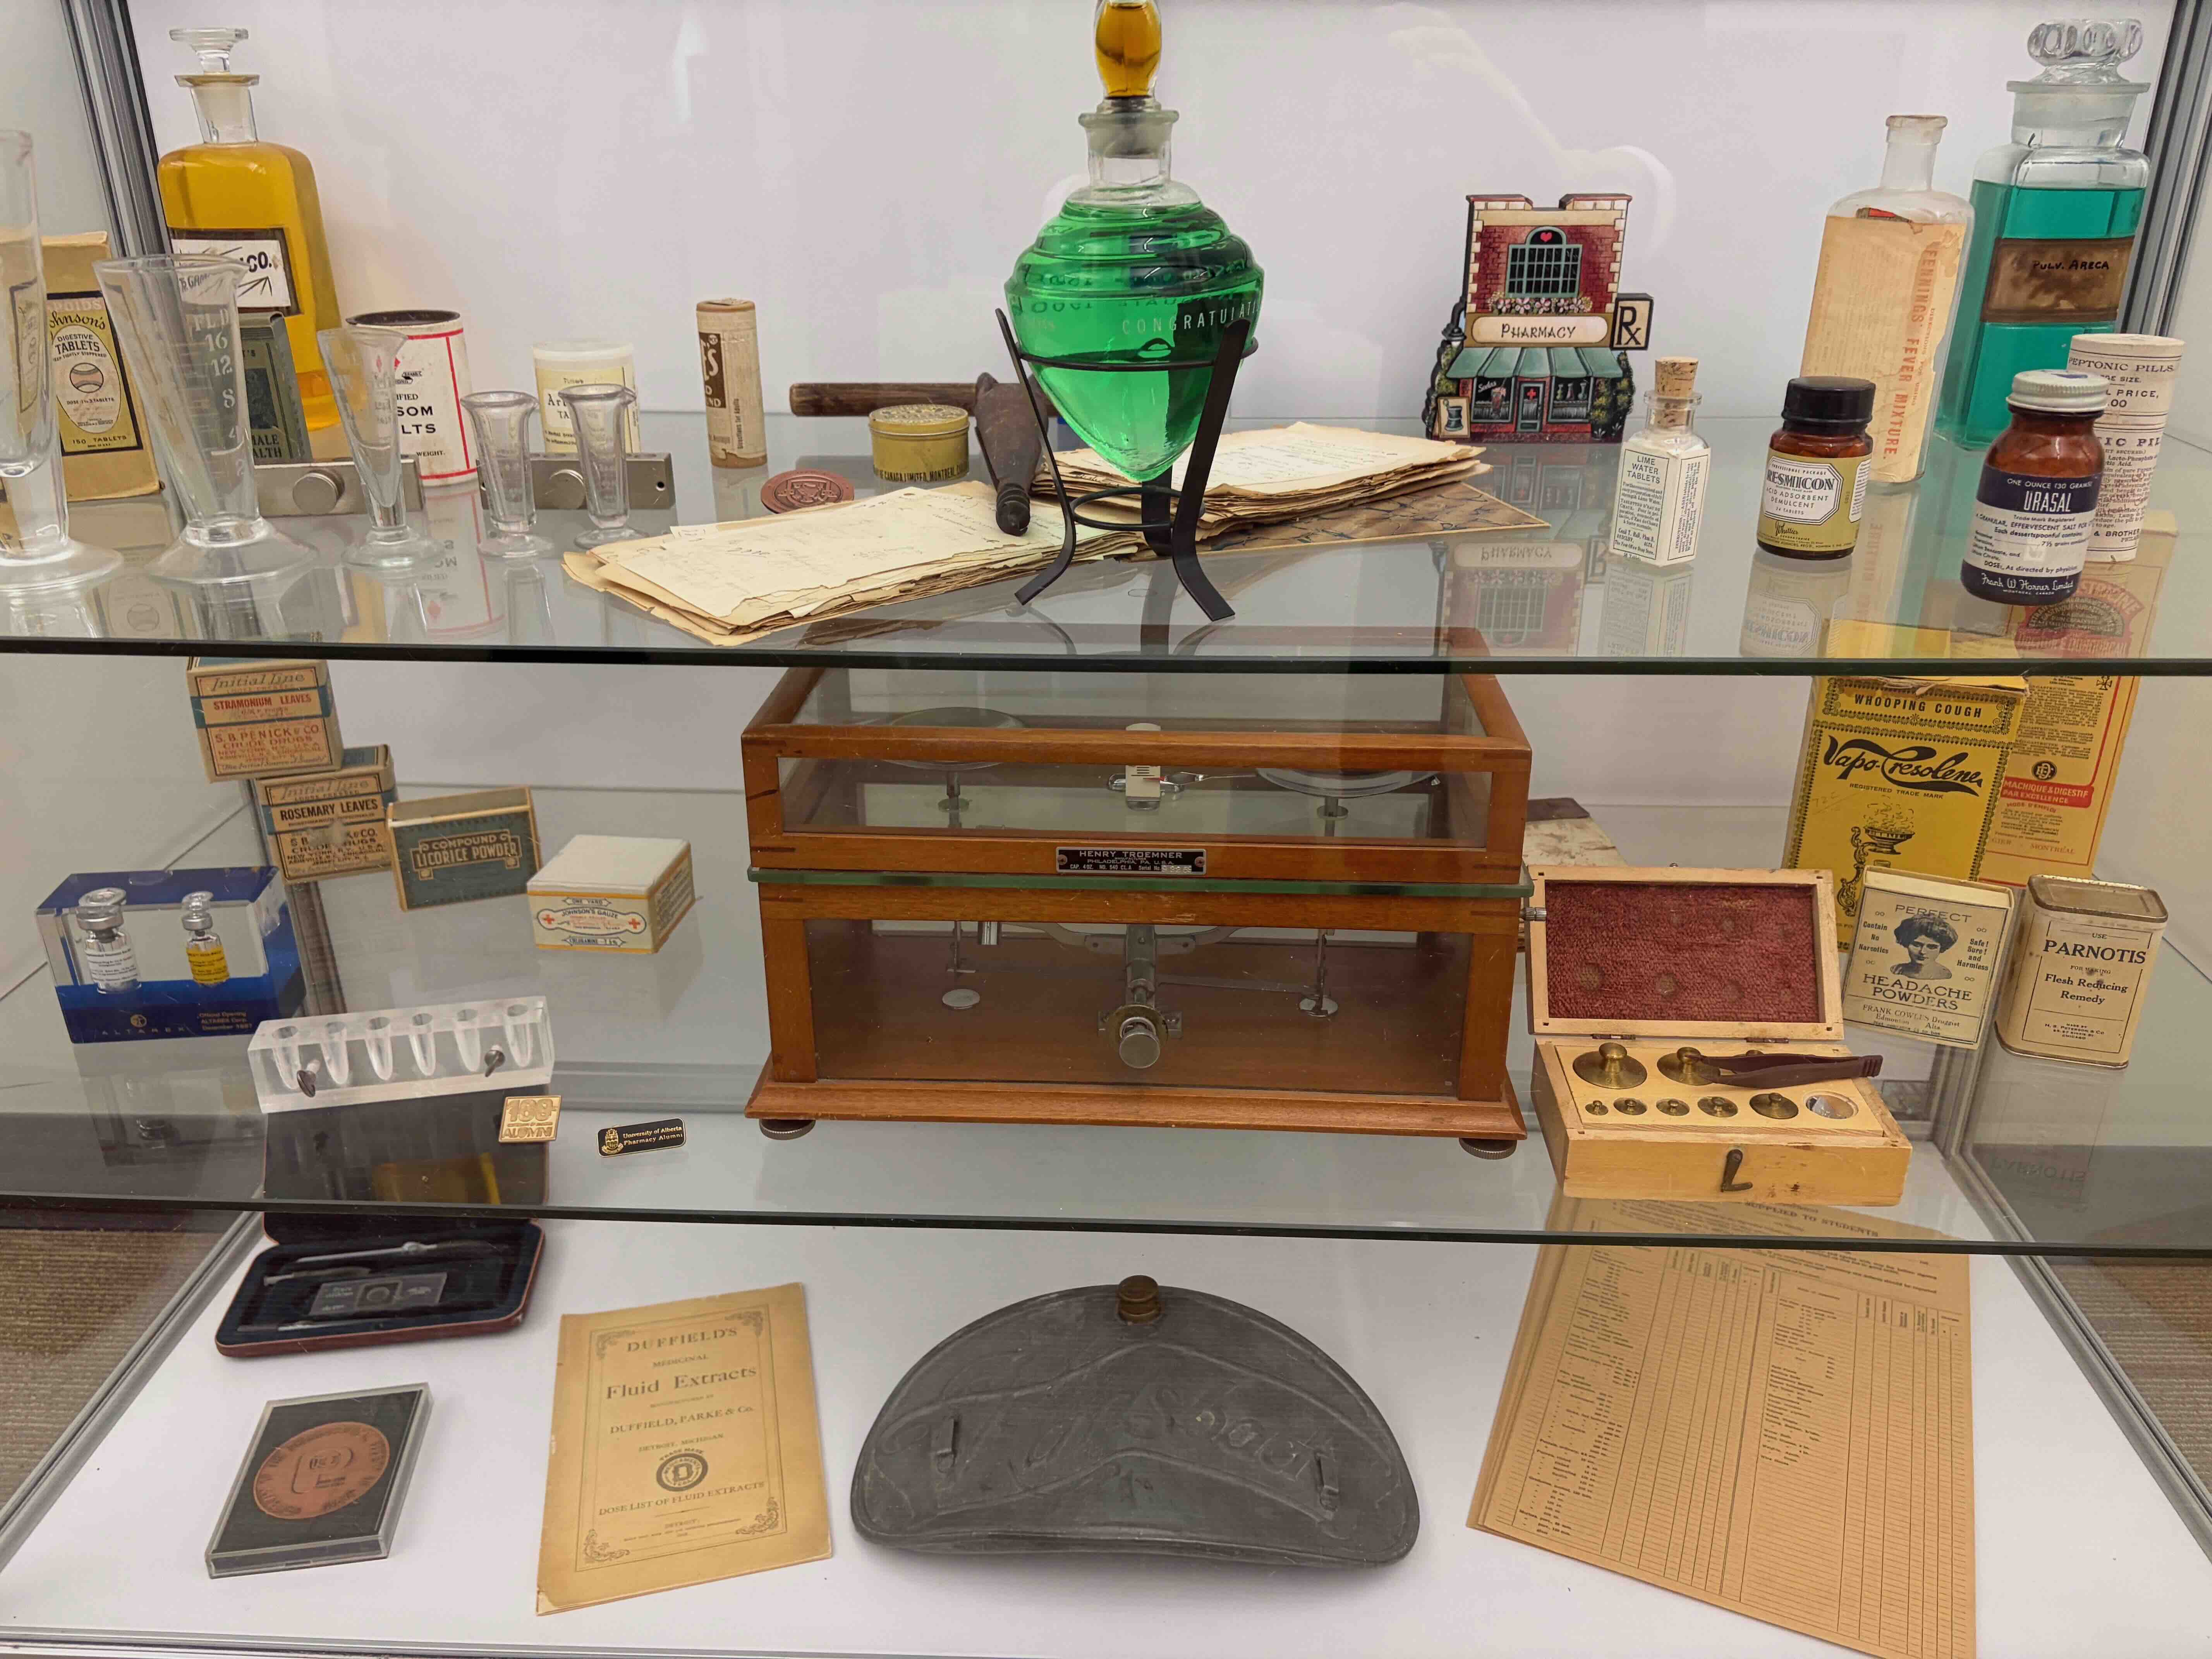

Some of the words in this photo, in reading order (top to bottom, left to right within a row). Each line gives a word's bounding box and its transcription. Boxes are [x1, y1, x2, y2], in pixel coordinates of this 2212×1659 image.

[2069, 260, 2109, 270] ARECA
[1911, 250, 1939, 328] FENNINGS'
[50, 310, 106, 330] ohnson's
[57, 333, 93, 342] DIGESTIVE
[1501, 323, 1576, 339] PHARMACY
[55, 340, 100, 355] TABLETS
[205, 331, 228, 352] 16
[211, 355, 232, 376] 12
[1899, 338, 1921, 383] FEVER
[2069, 357, 2129, 371] PEPTONIC
[2116, 389, 2159, 398] PRICE,
[397, 405, 433, 417] SOM
[401, 424, 436, 434] LTS
[1883, 393, 1908, 460] MIXTURE.
[1637, 455, 1656, 465] LIME
[1632, 463, 1659, 475] WATER
[1772, 463, 1800, 474] PROFESSIONAL
[1627, 471, 1660, 484] TABLETS
[1766, 469, 1836, 490] RESMICON
[2024, 481, 2051, 489] OUNCE
[1771, 496, 1814, 508] DEMULCENT
[1779, 491, 1829, 501] ADSORBENT
[2024, 490, 2071, 512] URASAL
[2011, 522, 2059, 531] EFFERVESCENT
[2010, 530, 2060, 539] dessertspoonful
[2016, 564, 2044, 573] directed
[2046, 565, 2053, 573] by
[1981, 573, 2004, 587] Frank
[2007, 579, 2016, 589] W
[213, 696, 273, 710] STRAMONIUM
[280, 694, 312, 705] LEAVES
[1855, 694, 1926, 712] WHOOPING
[1935, 702, 1983, 718] COUGH
[240, 727, 292, 740] PENICK
[270, 737, 312, 745] DRUGS
[1850, 783, 1893, 793] REGISTERED
[2054, 786, 2089, 799] DIGESTIF
[2020, 791, 2069, 804] EXCELLENCE
[280, 804, 335, 821] ROSEMARY
[341, 799, 378, 814] LEAVES
[432, 834, 497, 850] COMPOUND
[415, 848, 468, 867] LICORICE
[472, 842, 517, 860] POWDER
[562, 908, 596, 917] JOHNSON'S
[598, 910, 618, 919] GAUZE
[1895, 904, 1973, 923] PERFECT
[1863, 921, 1888, 931] Contain
[1858, 944, 1889, 954] Narcotics
[2043, 939, 2147, 964] PARNOTIS
[1968, 954, 1982, 962] and
[1957, 960, 1989, 971] Harmless
[1862, 973, 1973, 1001] HEADACHE
[2044, 973, 2073, 986] Flesh
[2078, 978, 2129, 993] Reducing
[1872, 986, 1959, 1010] POWDERS
[2060, 990, 2106, 1005] Remedy
[1862, 1004, 1892, 1015] FRANK
[623, 1130, 653, 1139] University
[661, 1126, 682, 1134] Alberta
[624, 1137, 657, 1146] Pharmacy
[659, 1133, 683, 1141] Alumni
[1821, 1219, 1879, 1237] STUDENTS
[627, 1327, 737, 1353] DUFFIELD'S
[652, 1353, 709, 1368] MEDICINAL
[606, 1379, 660, 1399] Fluid
[674, 1366, 757, 1389] Extracts
[610, 1417, 678, 1434] DUFFIELD,
[680, 1408, 723, 1424] PARKE
[680, 1433, 724, 1446] MICHIGAN
[599, 1504, 629, 1516] DOSE
[630, 1501, 654, 1511] LIST
[655, 1498, 670, 1506] OF
[672, 1492, 705, 1504] FLUID
[707, 1481, 766, 1497] EXTRACTS
